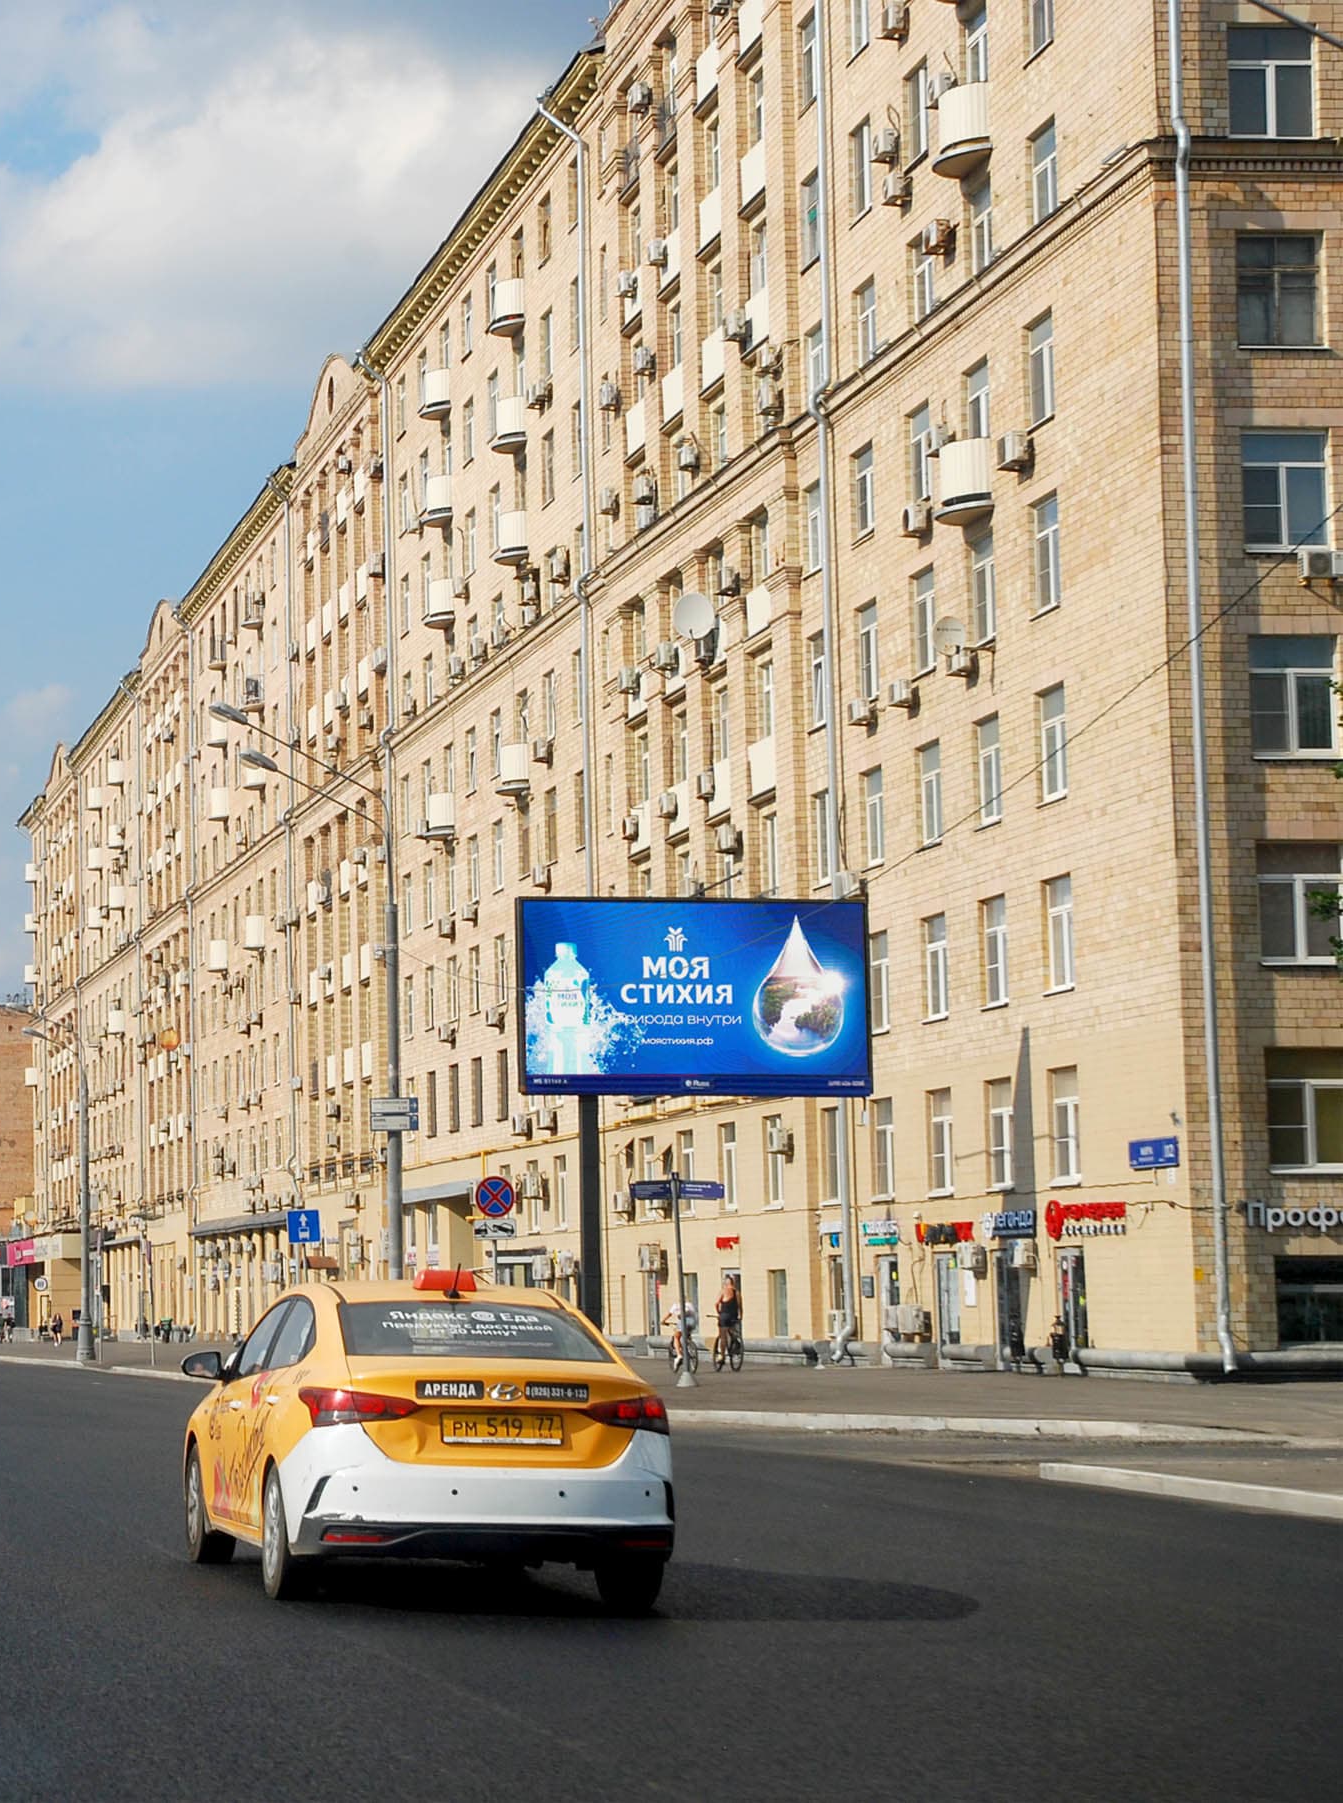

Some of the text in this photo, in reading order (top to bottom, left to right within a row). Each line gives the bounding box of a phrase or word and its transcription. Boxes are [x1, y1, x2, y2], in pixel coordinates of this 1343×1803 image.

[642, 956, 710, 979] МОЯ
[620, 983, 733, 1005] СТИХИЯ
[687, 1014, 742, 1027] внутри
[641, 1037, 714, 1046] моястихия.рф
[1247, 1200, 1343, 1233] Проф
[389, 1310, 540, 1324] Яндекс Еда
[381, 1321, 465, 1330] Продукты
[474, 1323, 554, 1332] доставкой
[470, 1329, 518, 1337] минут
[424, 1383, 477, 1398] АРЕНДА
[452, 1417, 554, 1438] РМ 519 77
